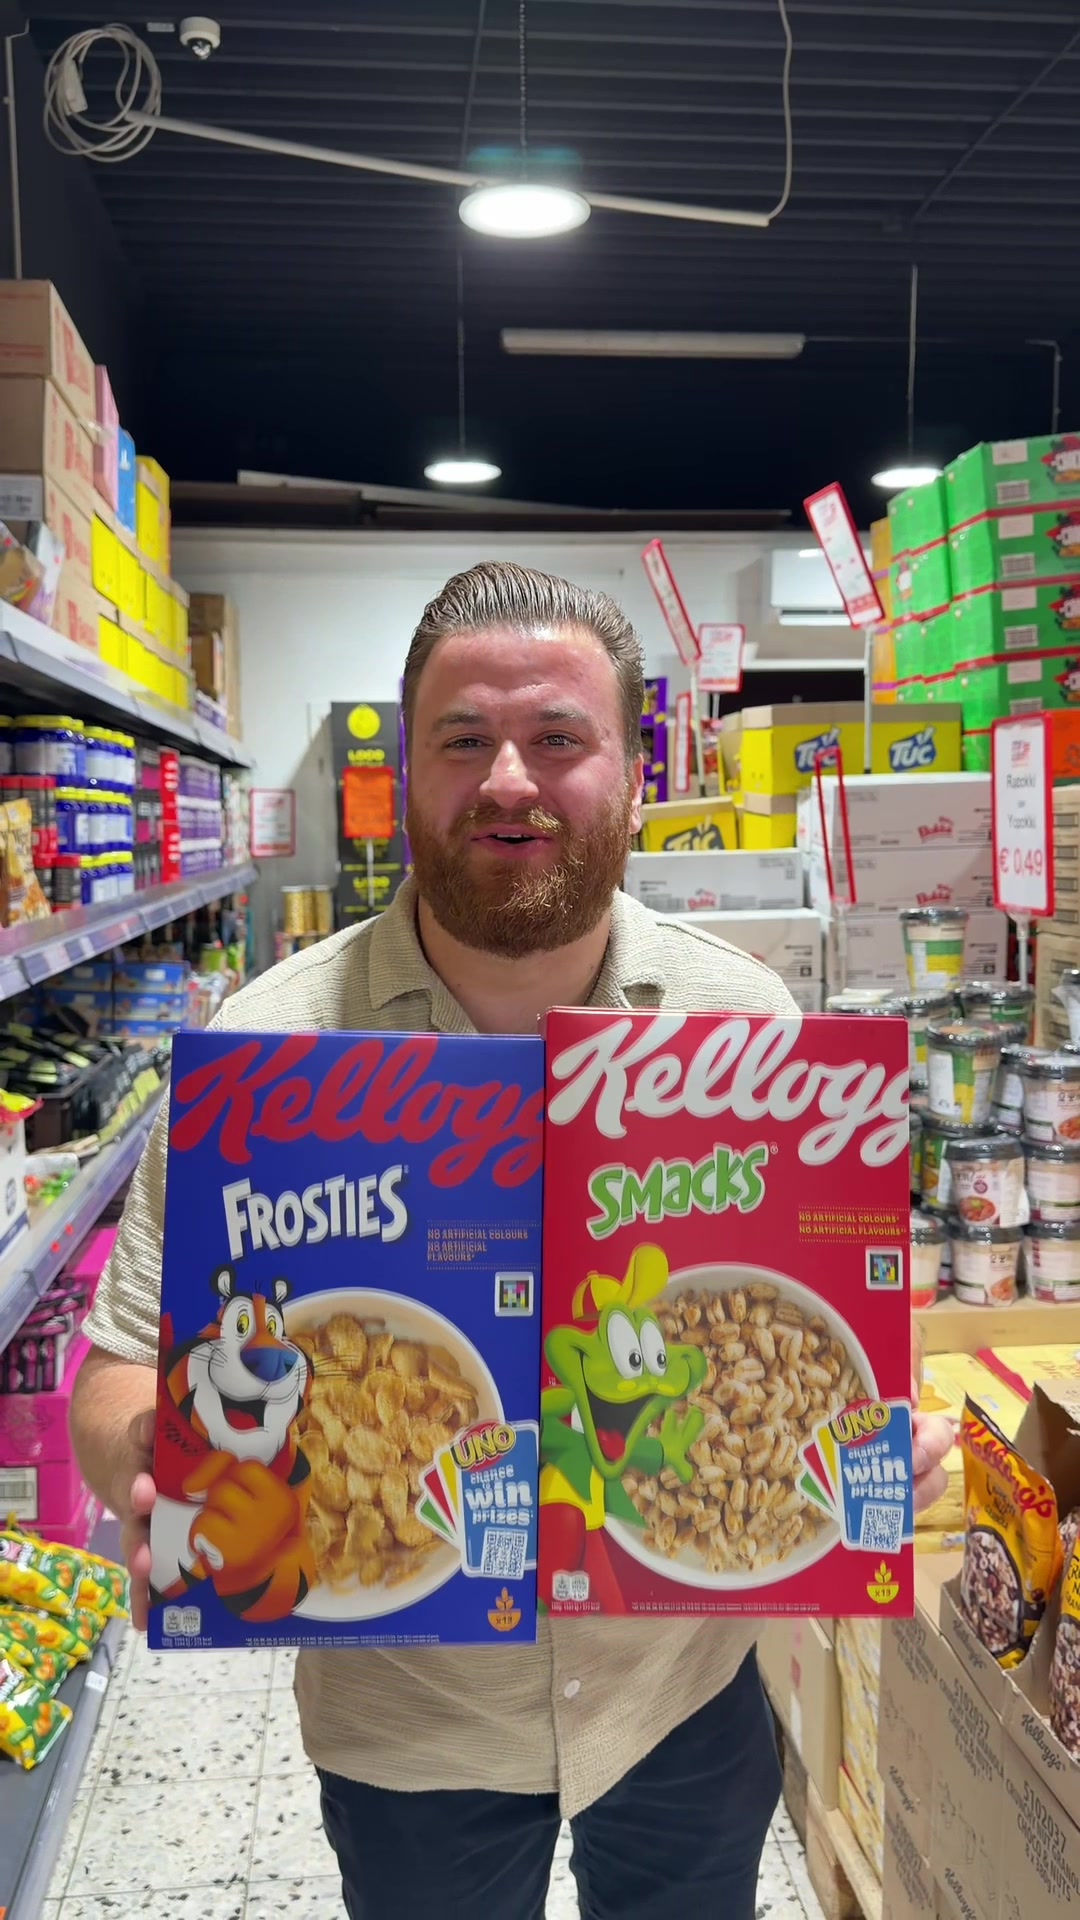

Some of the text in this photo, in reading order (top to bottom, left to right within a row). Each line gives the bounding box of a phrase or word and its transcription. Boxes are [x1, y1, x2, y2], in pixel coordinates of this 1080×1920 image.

[889, 740, 933, 768] TUC
[1000, 848, 1009, 874] €
[799, 1211, 812, 1222] NO
[813, 1211, 857, 1223] ARTIFICIAL
[799, 1223, 812, 1234] NO
[813, 1223, 857, 1235] ARTIFICIAL
[427, 1229, 440, 1240] NO
[442, 1229, 488, 1240] ARTIFICIAL
[427, 1241, 487, 1252] NO ARTIFICIAL
[829, 1401, 891, 1444] UNO
[450, 1422, 517, 1470] UNO
[848, 1440, 890, 1460] chance
[470, 1464, 515, 1485] chance
[843, 1456, 908, 1486] win
[464, 1480, 534, 1510] win
[1022, 1713, 1066, 1772] Kellogg's
[1023, 1779, 1067, 1854] 5102037
[1050, 1859, 1071, 1902] NUTS
